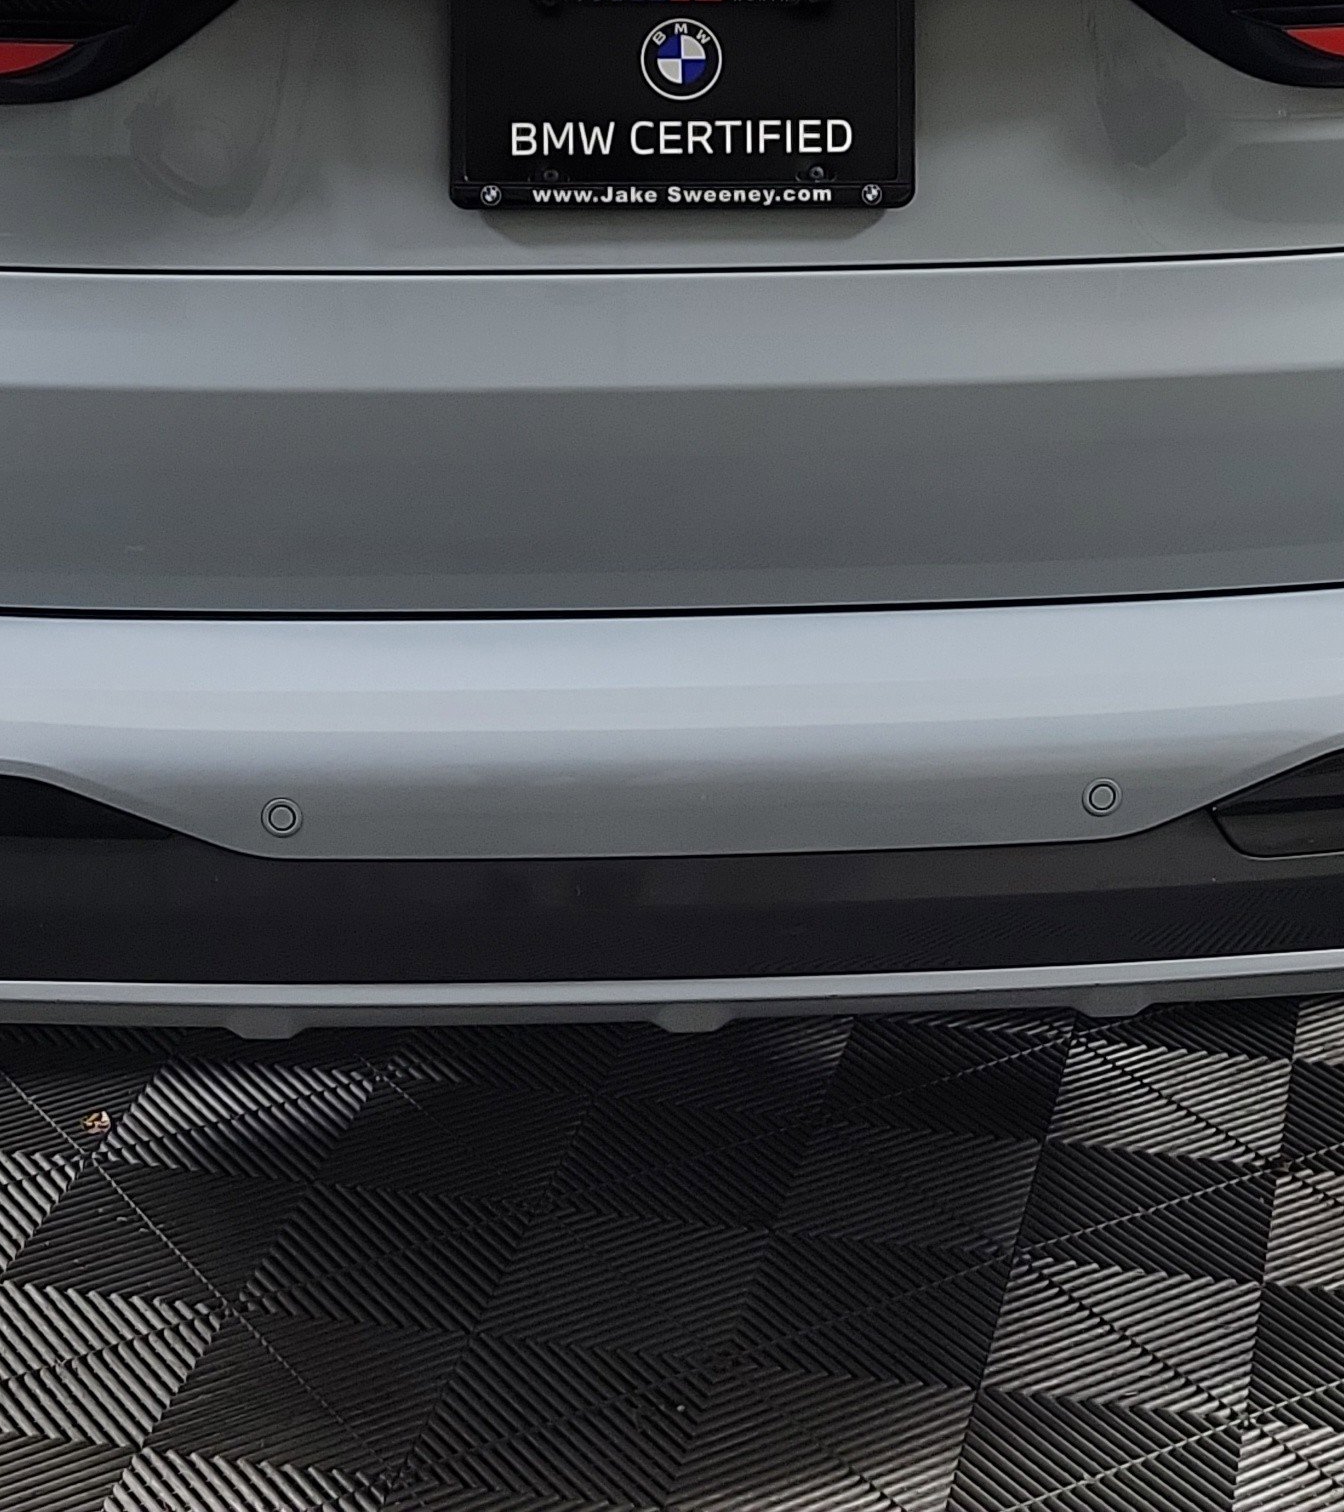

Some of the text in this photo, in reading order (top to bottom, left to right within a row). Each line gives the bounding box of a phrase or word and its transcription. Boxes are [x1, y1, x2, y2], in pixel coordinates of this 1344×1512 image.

[651, 23, 712, 47] BMW
[510, 119, 853, 156] BMW CERTIFIED
[532, 186, 833, 206] www.Jake Sweeney.com
